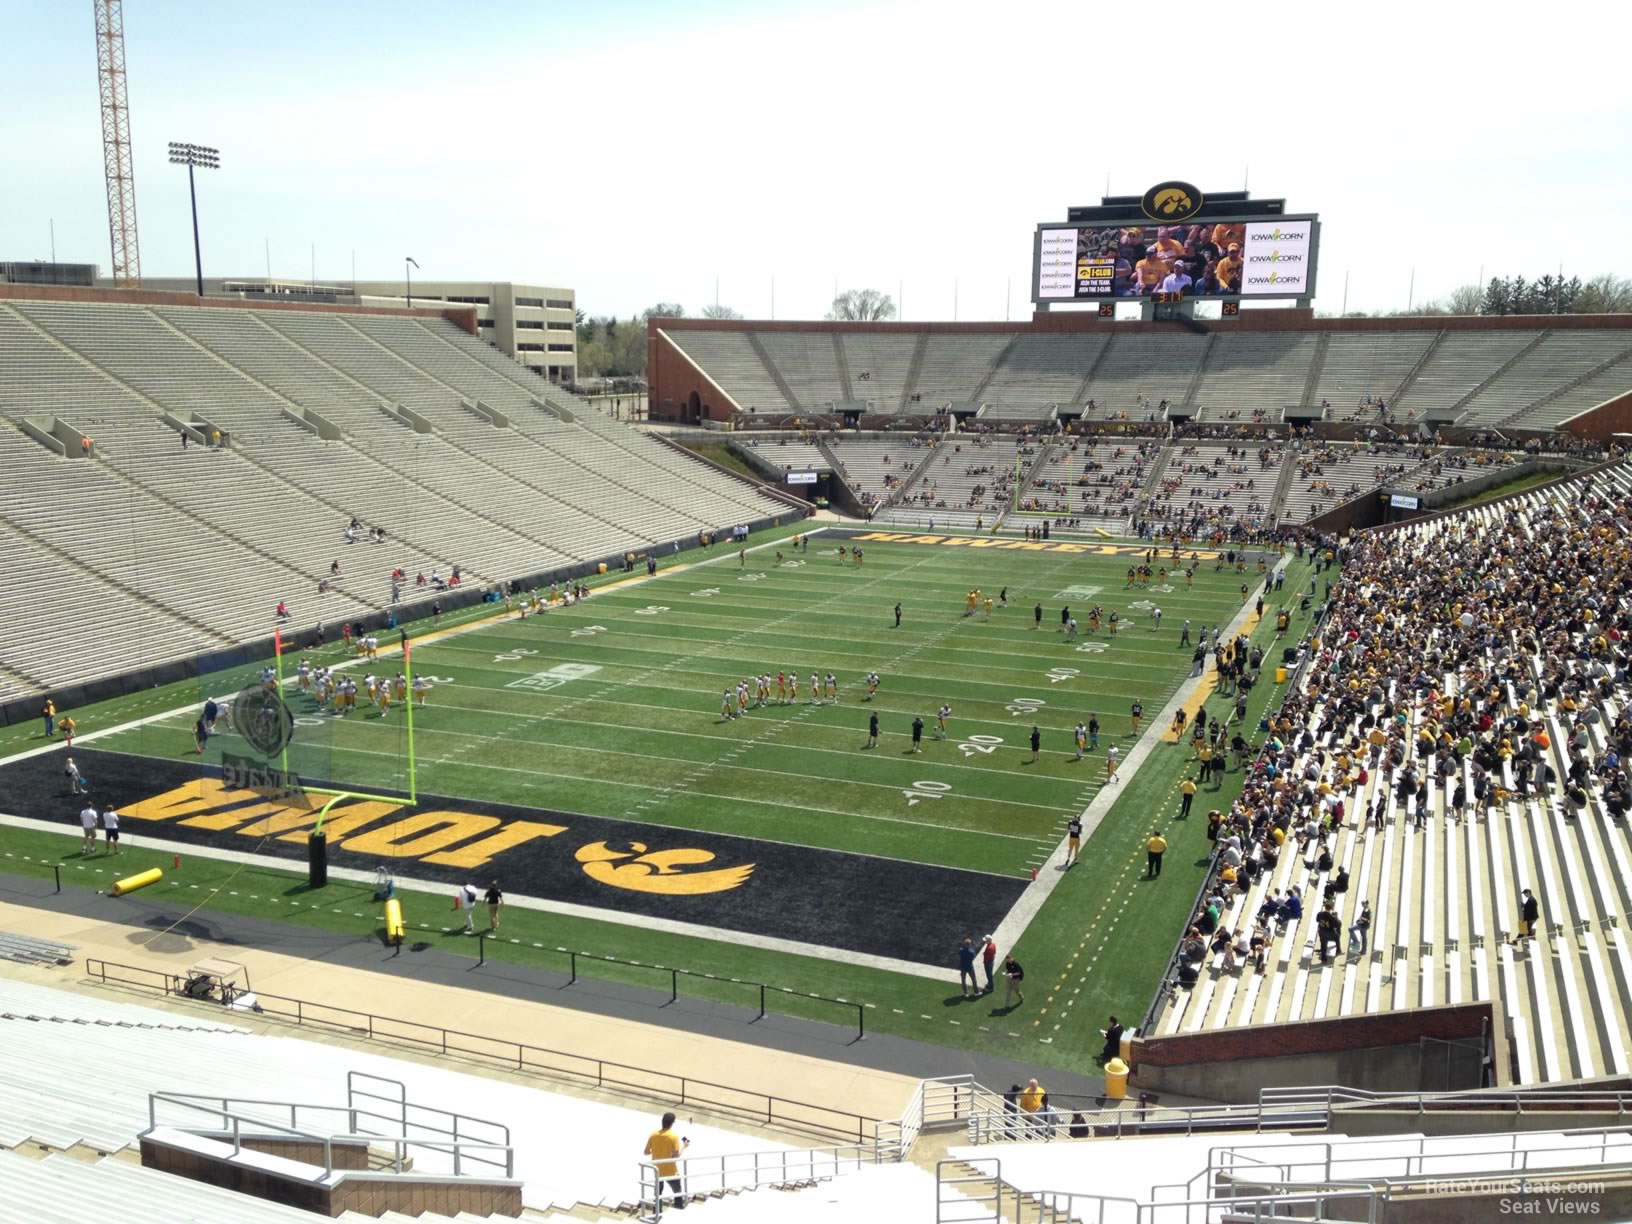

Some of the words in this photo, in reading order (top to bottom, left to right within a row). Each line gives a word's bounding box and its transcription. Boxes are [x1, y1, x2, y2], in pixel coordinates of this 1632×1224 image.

[1100, 305, 1113, 316] 25
[1224, 304, 1236, 315] 25
[1045, 668, 1080, 682] 40
[1005, 698, 1046, 714] 30
[958, 735, 1004, 754] 20
[903, 781, 952, 799] 10
[117, 778, 568, 868] IOWA
